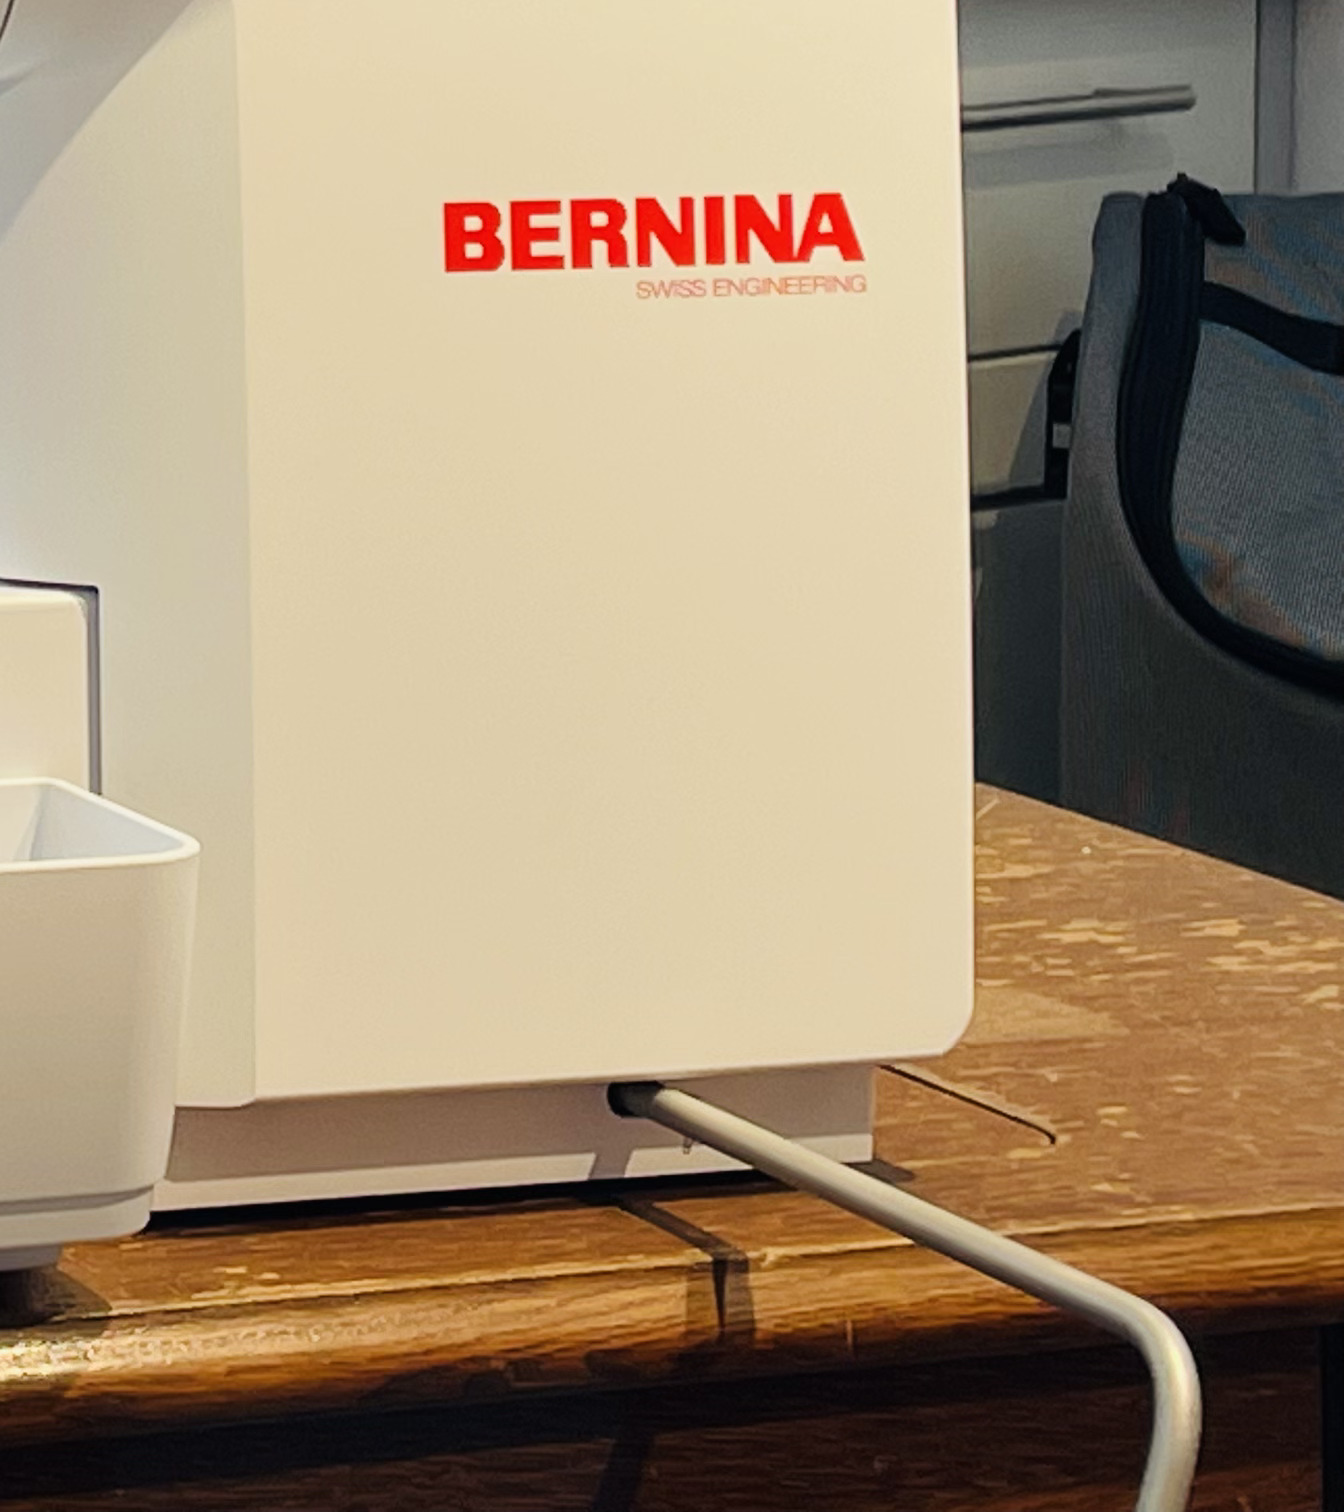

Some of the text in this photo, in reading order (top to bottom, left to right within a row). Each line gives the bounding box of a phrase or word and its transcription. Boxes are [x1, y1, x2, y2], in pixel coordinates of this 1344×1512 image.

[443, 192, 866, 272] BERNINA
[635, 275, 868, 300] SWISS ENGINEERING
